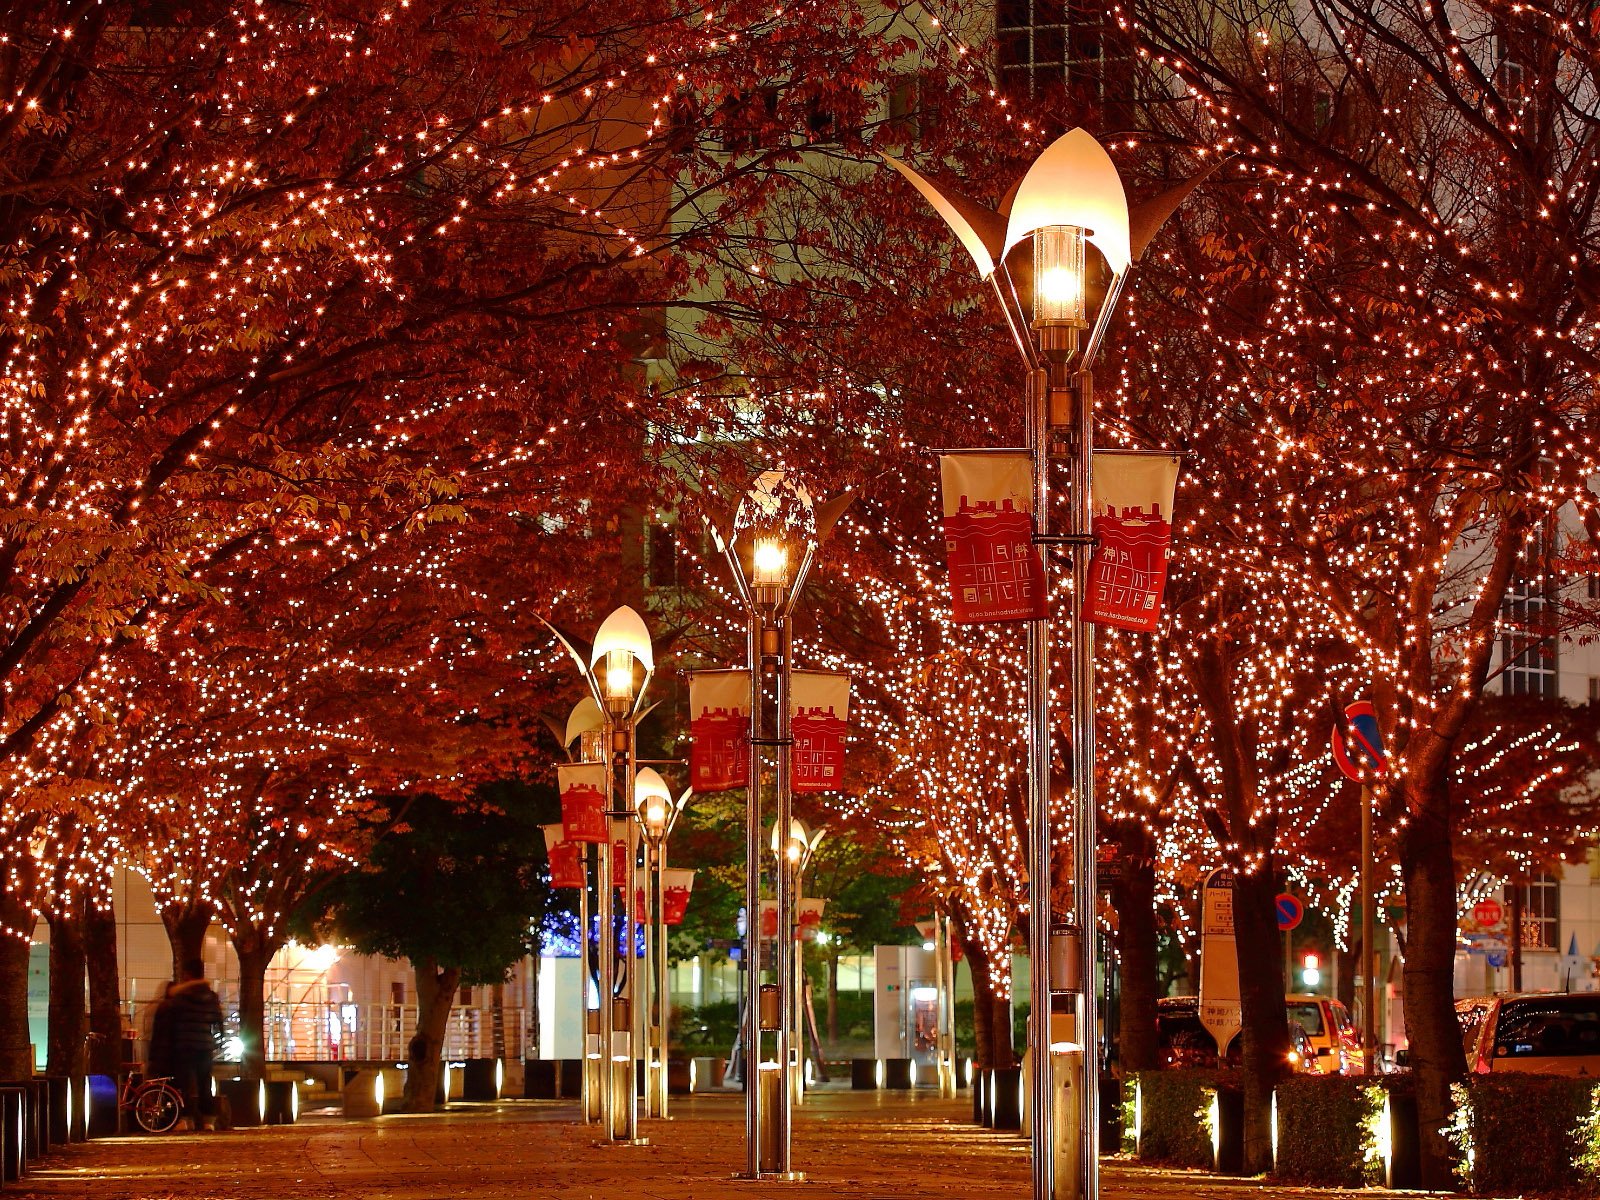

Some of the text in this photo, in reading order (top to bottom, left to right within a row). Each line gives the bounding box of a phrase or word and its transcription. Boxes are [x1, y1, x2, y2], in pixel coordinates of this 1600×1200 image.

[1103, 545, 1128, 564] 神戸
[1100, 565, 1158, 588] ハーバー
[1098, 585, 1142, 607] ランド
